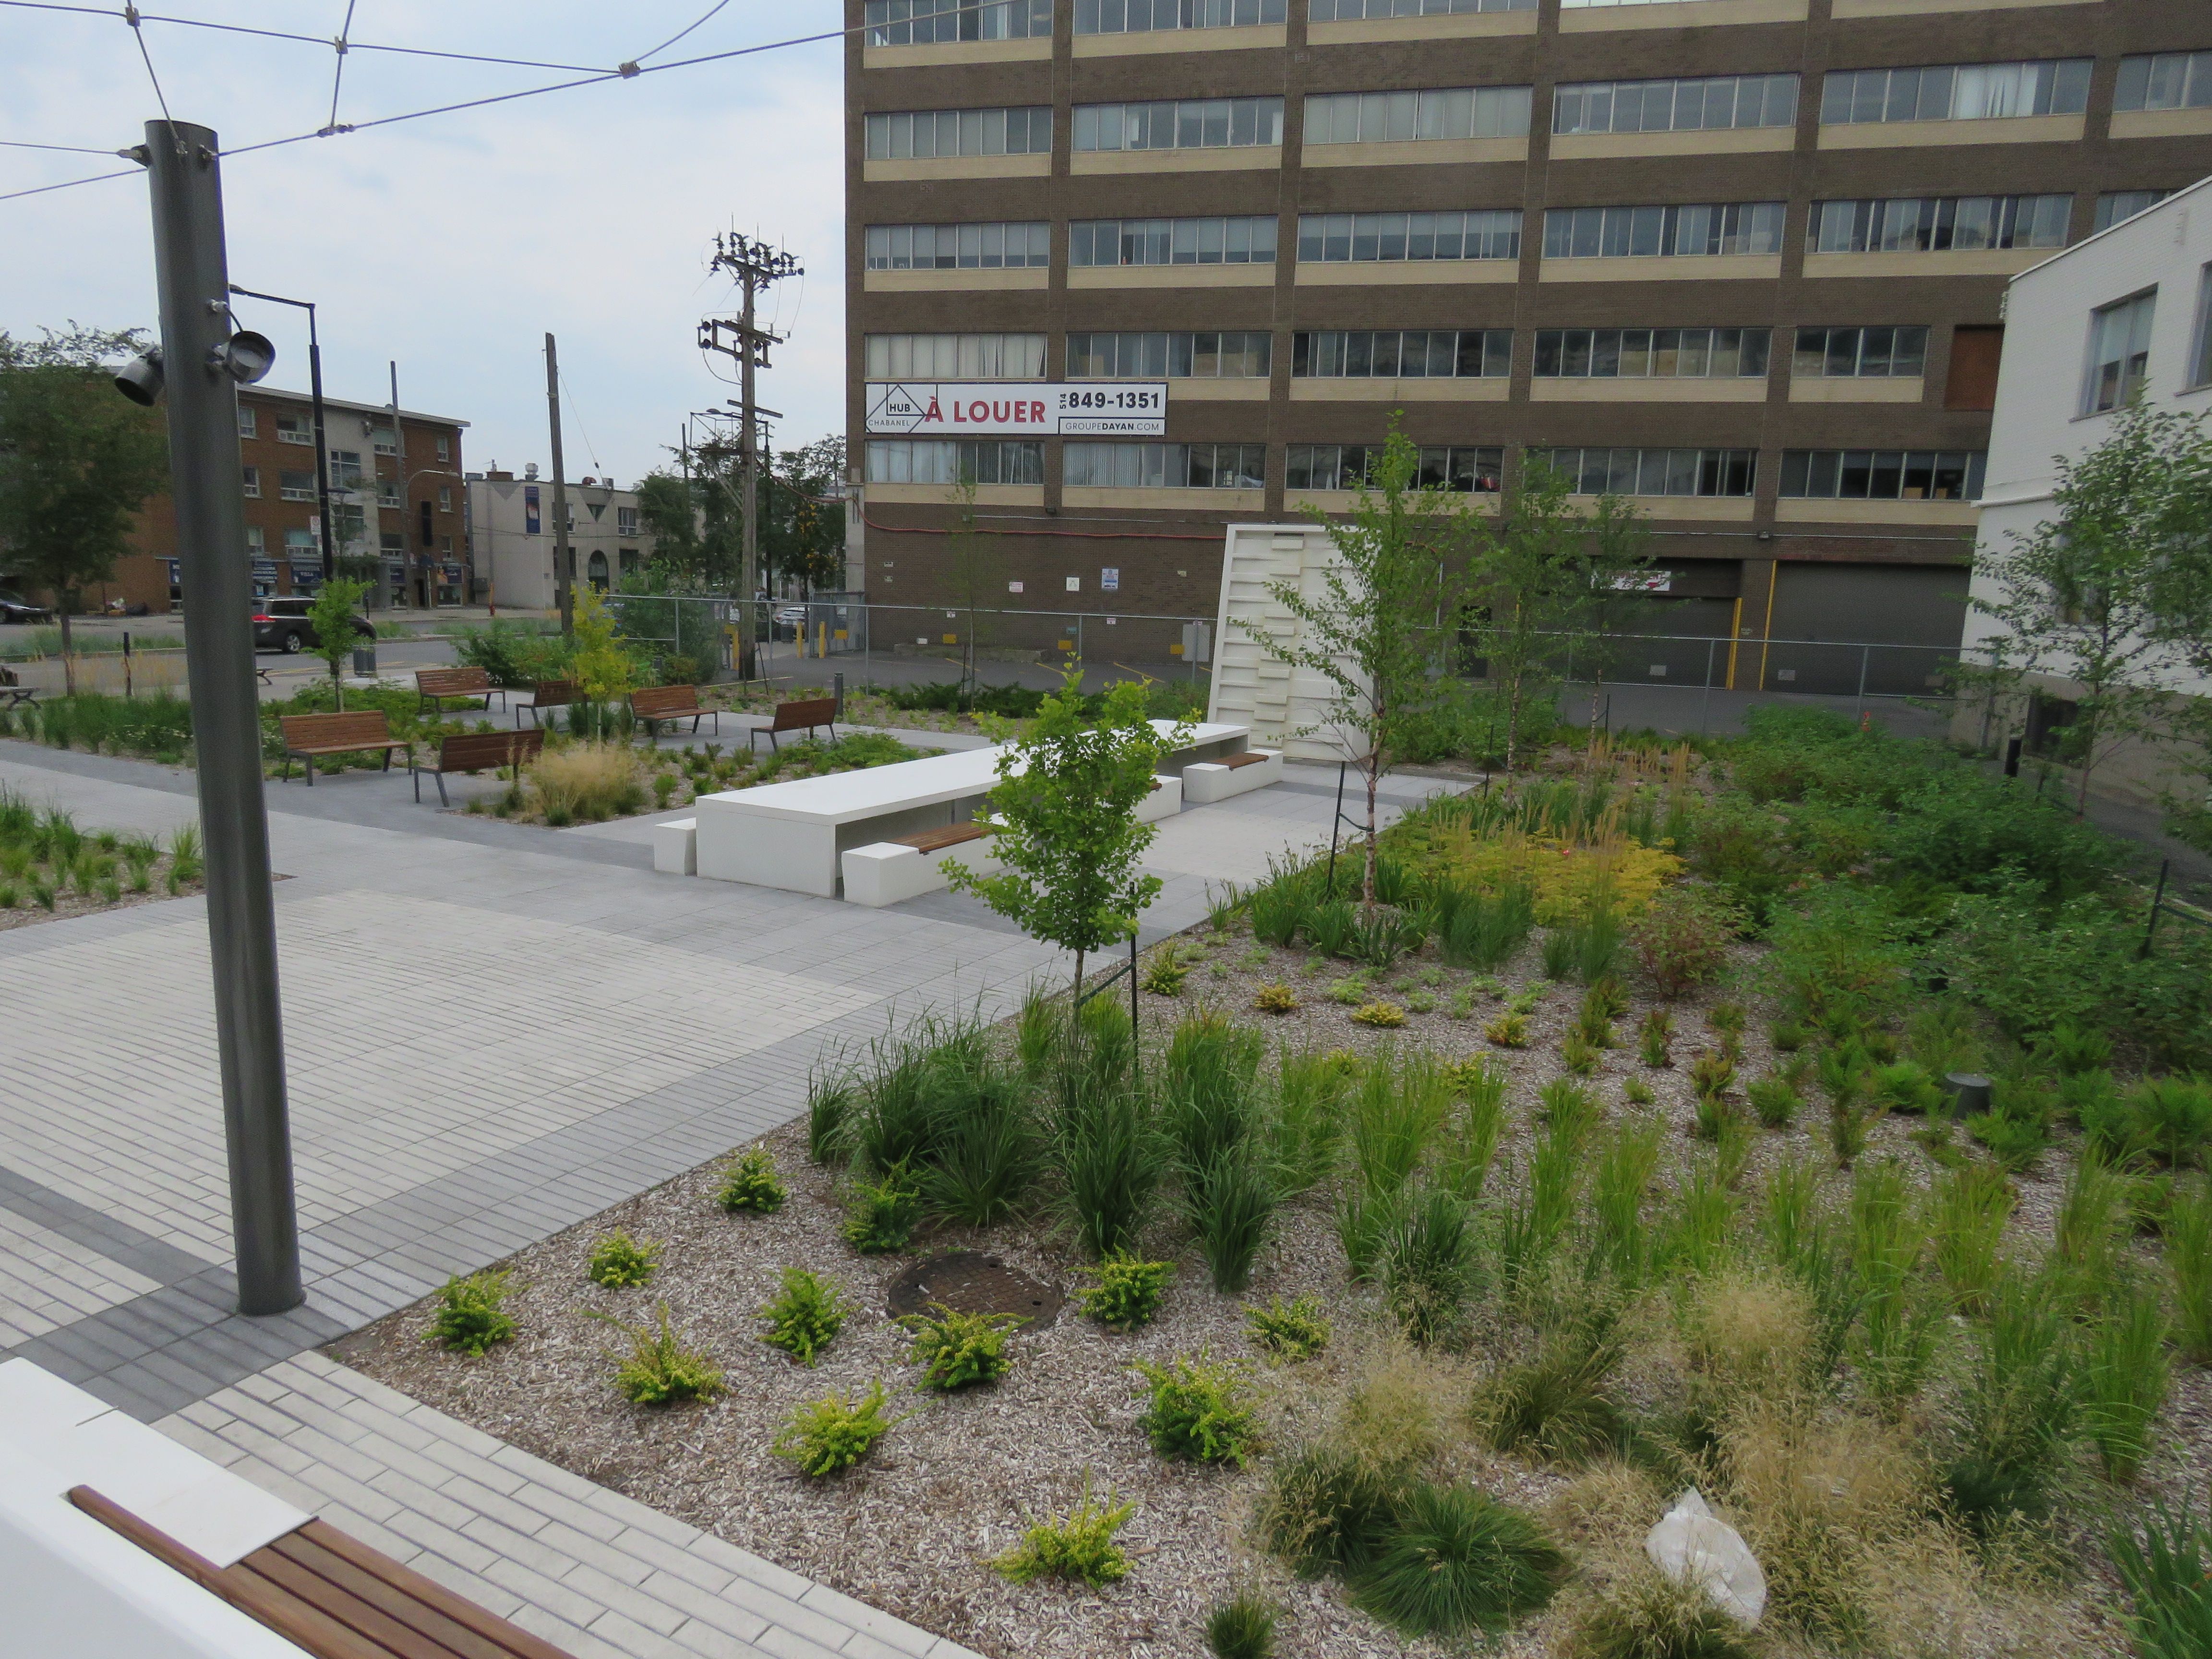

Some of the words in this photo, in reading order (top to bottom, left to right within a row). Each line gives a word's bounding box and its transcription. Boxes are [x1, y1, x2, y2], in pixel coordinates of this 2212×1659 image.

[1069, 392, 1158, 408] 849-1351
[890, 404, 911, 412] HUB
[925, 396, 944, 422] À
[954, 400, 1046, 423] LOUER
[1065, 422, 1159, 431] GROUPEDAYAN.COM
